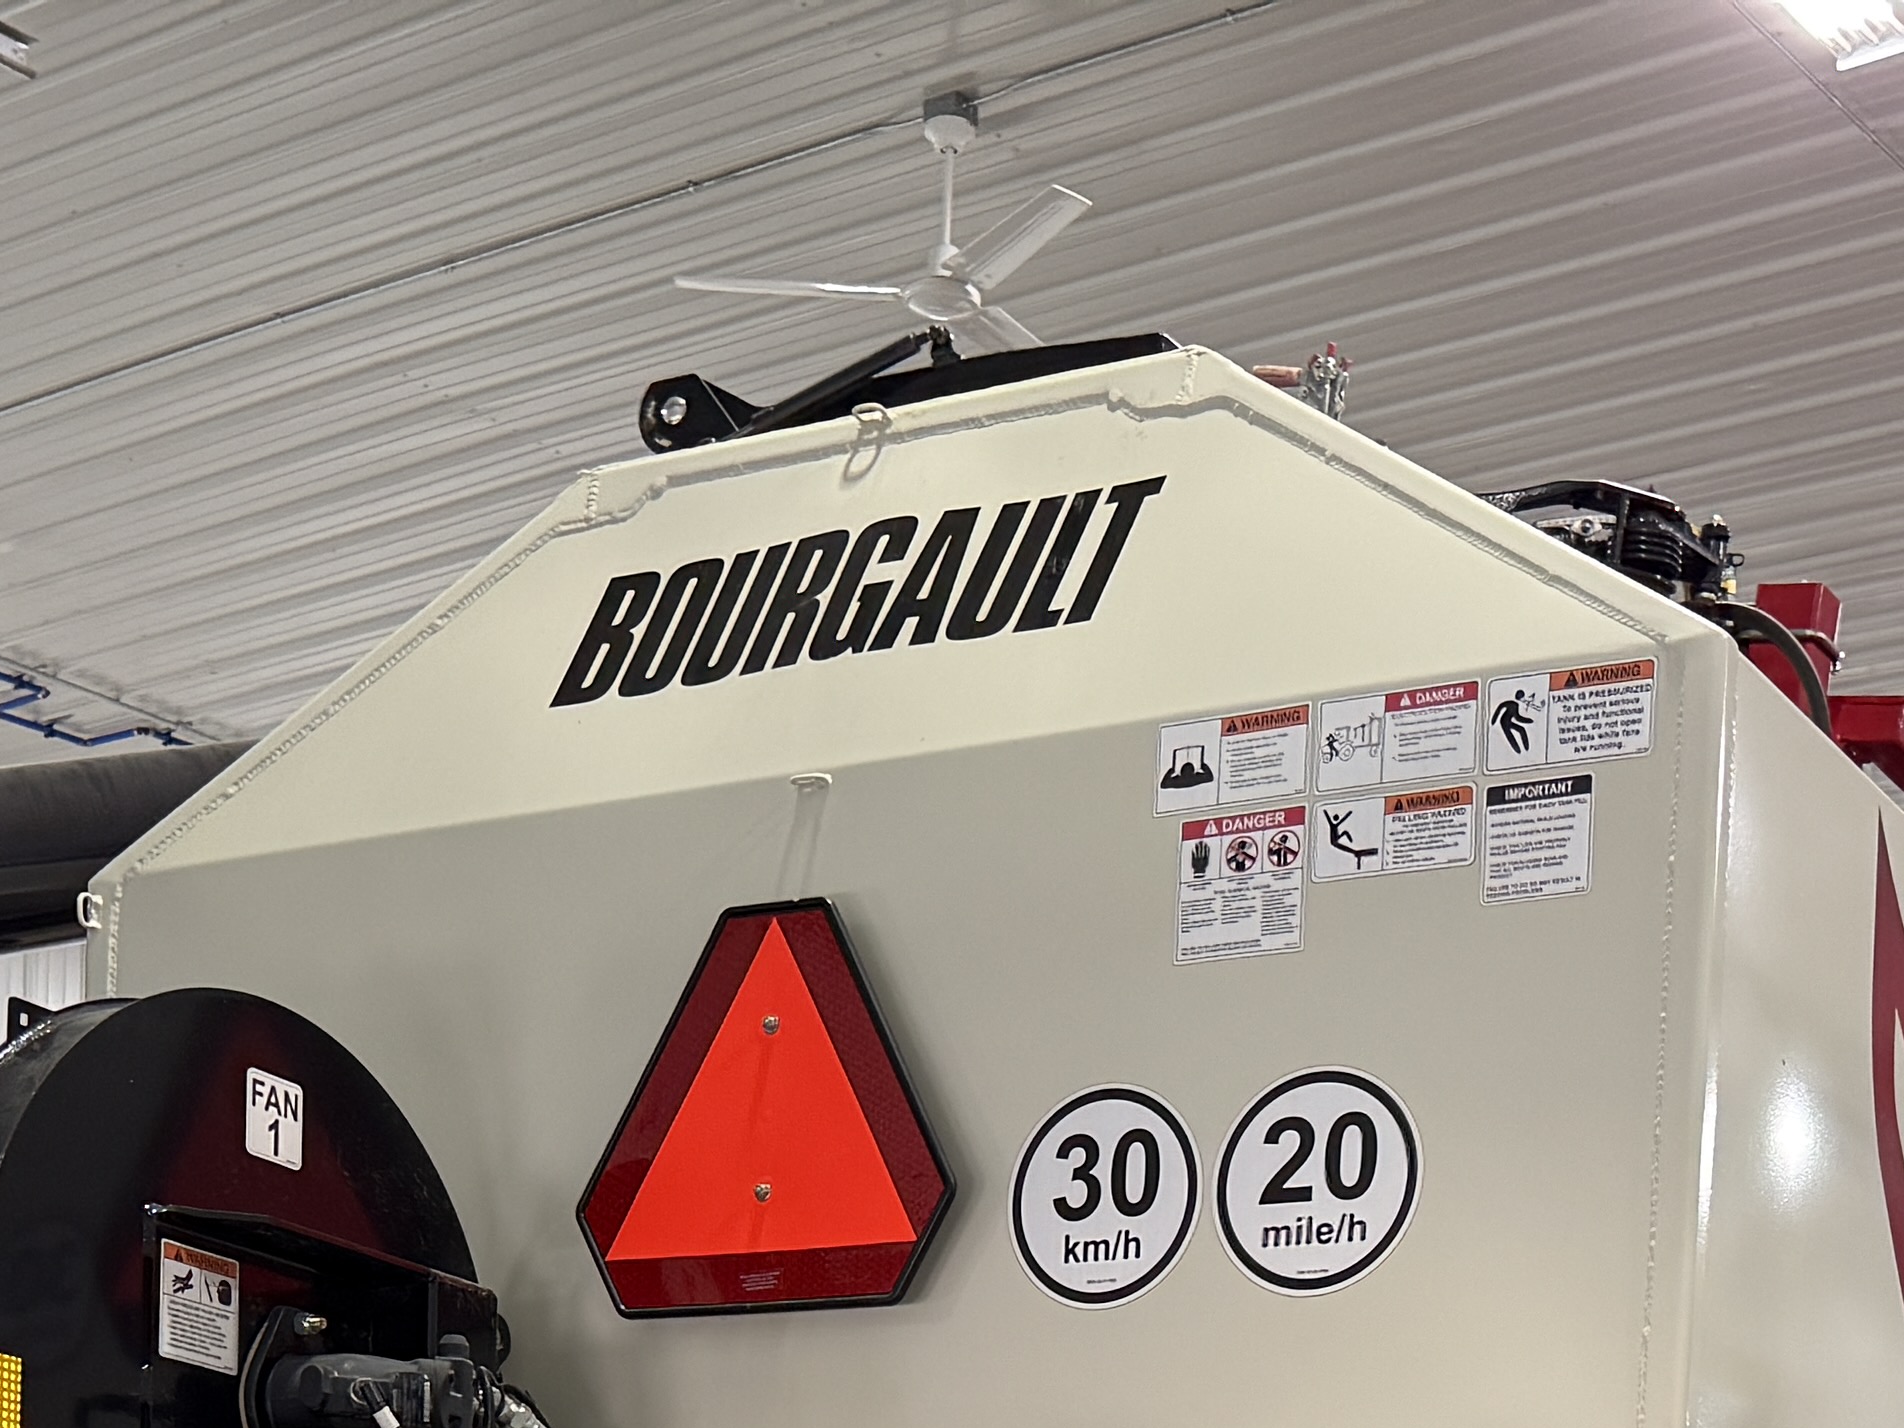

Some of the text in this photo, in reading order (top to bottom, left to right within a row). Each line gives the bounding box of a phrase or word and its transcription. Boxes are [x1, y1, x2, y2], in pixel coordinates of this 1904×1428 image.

[549, 474, 1167, 708] BOURGAULT
[1580, 664, 1641, 685] WARNING
[1415, 688, 1465, 706] DANGER
[1552, 693, 1576, 704] TANK
[1588, 684, 1653, 699] PRESSURIZED
[1557, 706, 1644, 724] injury and functional
[1574, 701, 1607, 712] prevent
[1239, 711, 1302, 731] WARNING
[1591, 721, 1602, 731] do
[1604, 719, 1619, 729] not
[1620, 717, 1642, 728] open
[1597, 730, 1619, 740] while
[1406, 790, 1460, 810] WARNING
[1504, 780, 1574, 801] IMPORTANT
[1222, 811, 1286, 833] DANGER
[251, 1078, 299, 1122] FAN
[267, 1119, 280, 1157] 1
[1258, 1111, 1378, 1206] 20
[1052, 1128, 1161, 1222] 30
[1261, 1213, 1367, 1248] mile/h
[1063, 1230, 1141, 1265] km/h
[186, 1252, 230, 1274] WARNING
